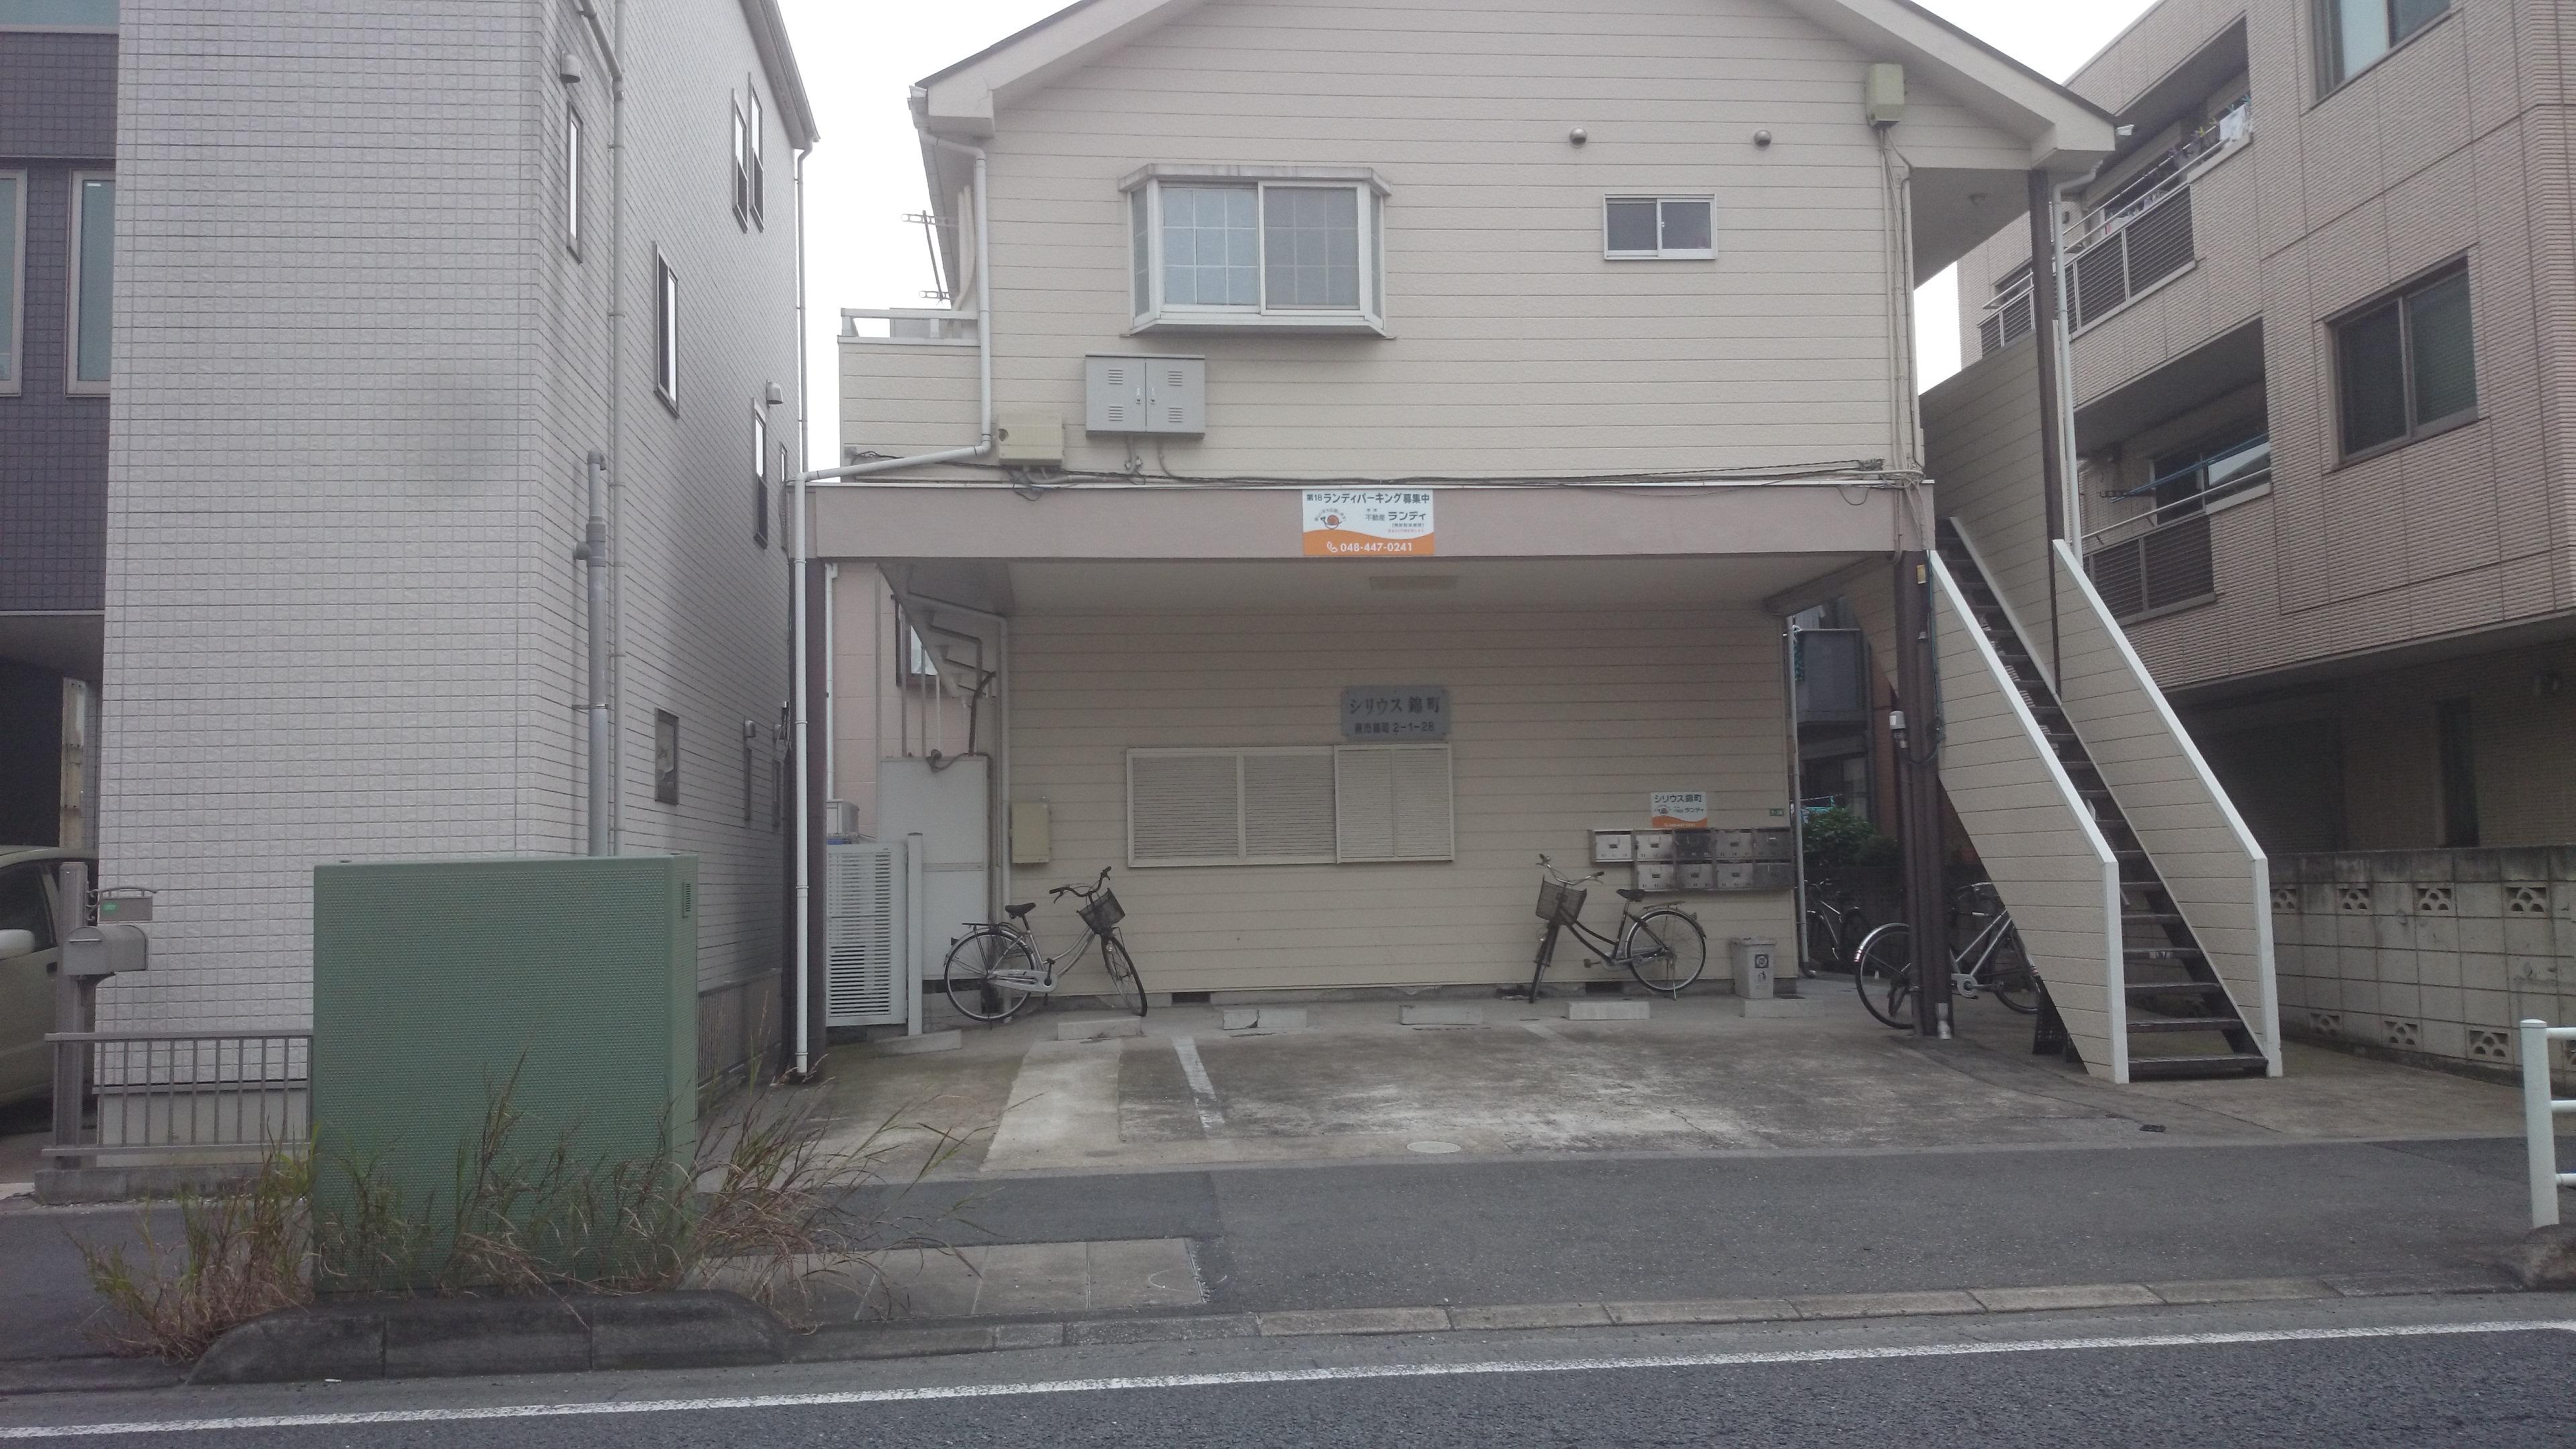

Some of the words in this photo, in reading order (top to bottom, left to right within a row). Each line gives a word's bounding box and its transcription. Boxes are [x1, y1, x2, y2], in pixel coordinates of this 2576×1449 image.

[1388, 511, 1427, 521] ランディ
[1340, 543, 1412, 552] 048-447-0241
[1654, 794, 1702, 803] シリウス錦町
